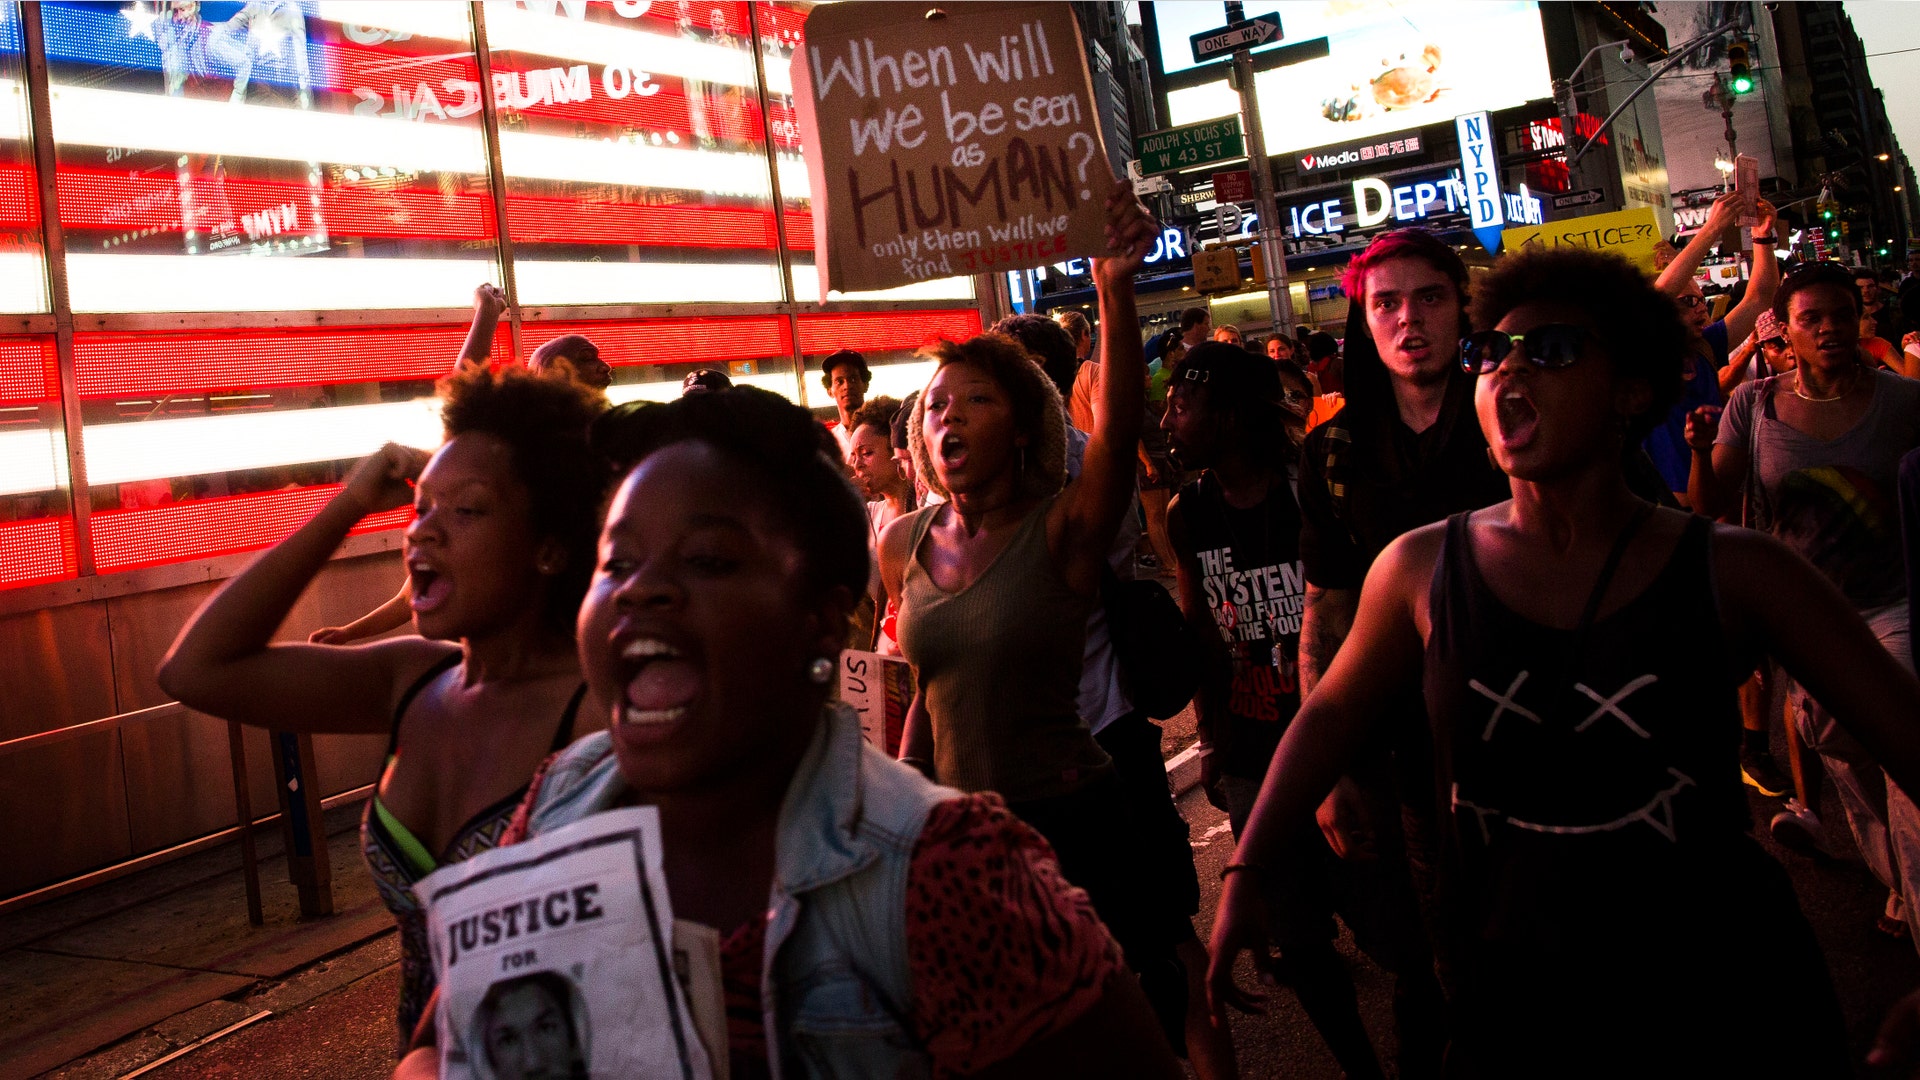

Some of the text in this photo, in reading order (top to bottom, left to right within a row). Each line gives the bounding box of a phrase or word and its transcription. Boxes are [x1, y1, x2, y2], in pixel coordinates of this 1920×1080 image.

[1204, 24, 1267, 51] ONE WAY
[811, 38, 957, 100] When
[850, 104, 928, 156] we
[941, 90, 1007, 143] be
[1013, 93, 1081, 131] seen
[1143, 131, 1180, 154] ADOLPH
[1194, 127, 1220, 143] OCHS
[1224, 122, 1236, 136] ST
[952, 142, 985, 168] as
[1159, 142, 1223, 168] W 43 ST
[1465, 117, 1494, 222] NYPD
[847, 132, 1094, 248] HUMAN?
[1226, 173, 1237, 182] NO
[1180, 190, 1216, 204] SHERW
[873, 229, 918, 259] only
[923, 229, 981, 252] then
[1037, 214, 1068, 238] we
[1144, 226, 1205, 262] ORK
[902, 253, 951, 280] find
[960, 234, 1067, 270] JUSTICE
[1139, 309, 1181, 328] POLIC
[1197, 547, 1234, 577] THE
[1203, 560, 1304, 609] SYSTEM
[1255, 595, 1304, 620] FUTUR
[1237, 620, 1266, 641] THE
[1266, 612, 1303, 636] YOU
[449, 883, 603, 966] JUSTICE
[501, 950, 538, 972] FOR
